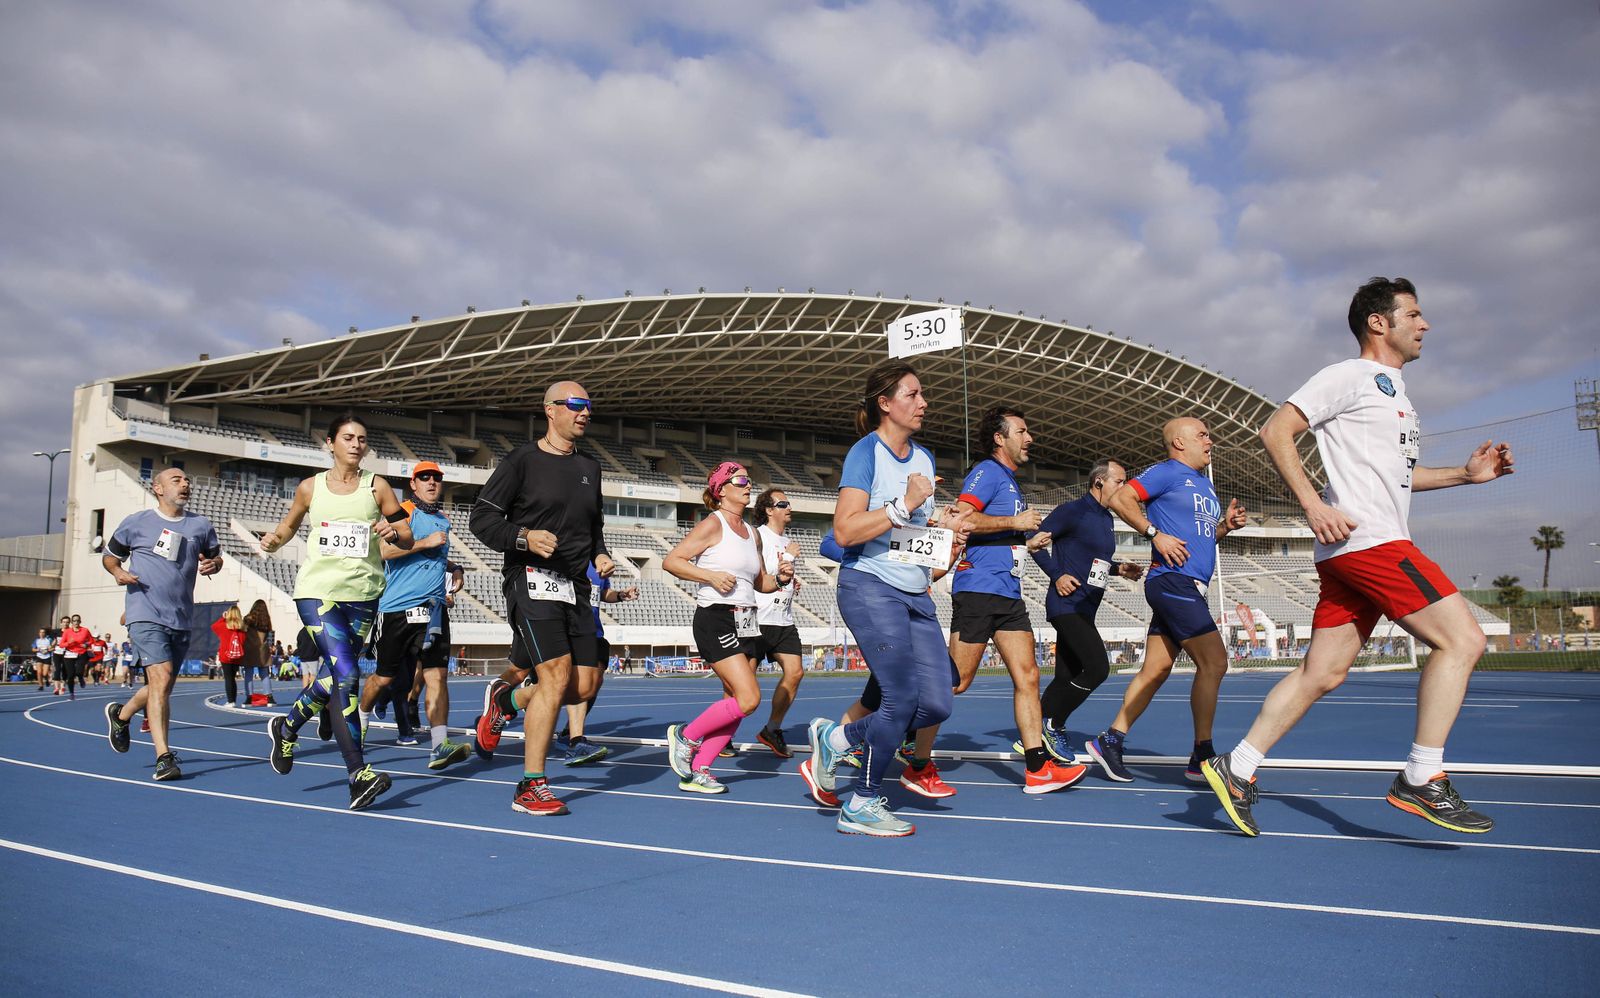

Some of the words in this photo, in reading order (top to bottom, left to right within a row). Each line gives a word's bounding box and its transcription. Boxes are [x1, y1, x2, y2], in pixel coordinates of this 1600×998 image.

[904, 317, 946, 340] 5:30
[910, 340, 940, 350] min/km
[1193, 493, 1221, 519] RCM
[1195, 520, 1217, 542] 187
[333, 535, 356, 548] 303
[906, 538, 934, 555] 123
[544, 581, 559, 592] 28
[742, 618, 751, 629] 24
